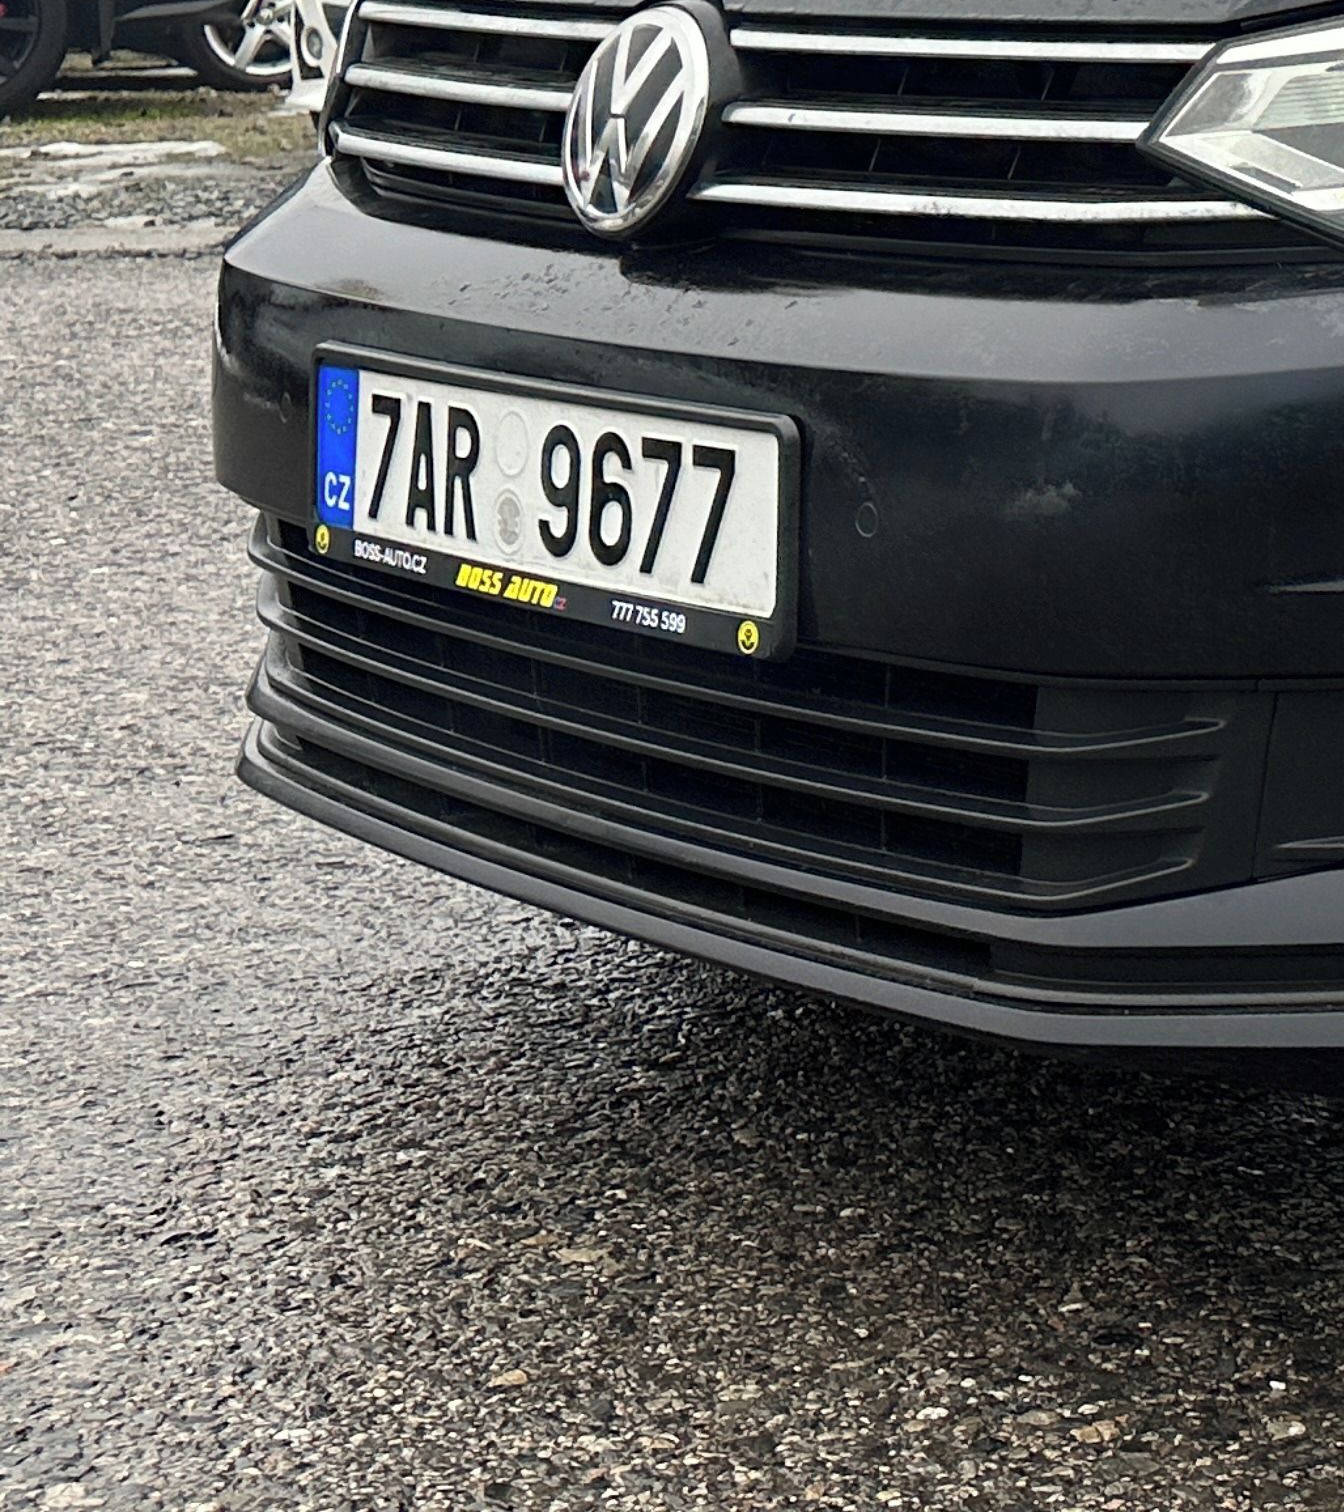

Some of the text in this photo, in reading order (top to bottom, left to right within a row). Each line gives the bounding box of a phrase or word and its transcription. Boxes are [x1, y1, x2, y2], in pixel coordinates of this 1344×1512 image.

[324, 471, 351, 511] CZ
[368, 393, 736, 585] 7AR 9677
[353, 539, 428, 576] BOSS-AUTO.CZ
[455, 563, 503, 595] BOSS
[503, 576, 559, 609] AUTO
[611, 599, 687, 634] 777 755 599
